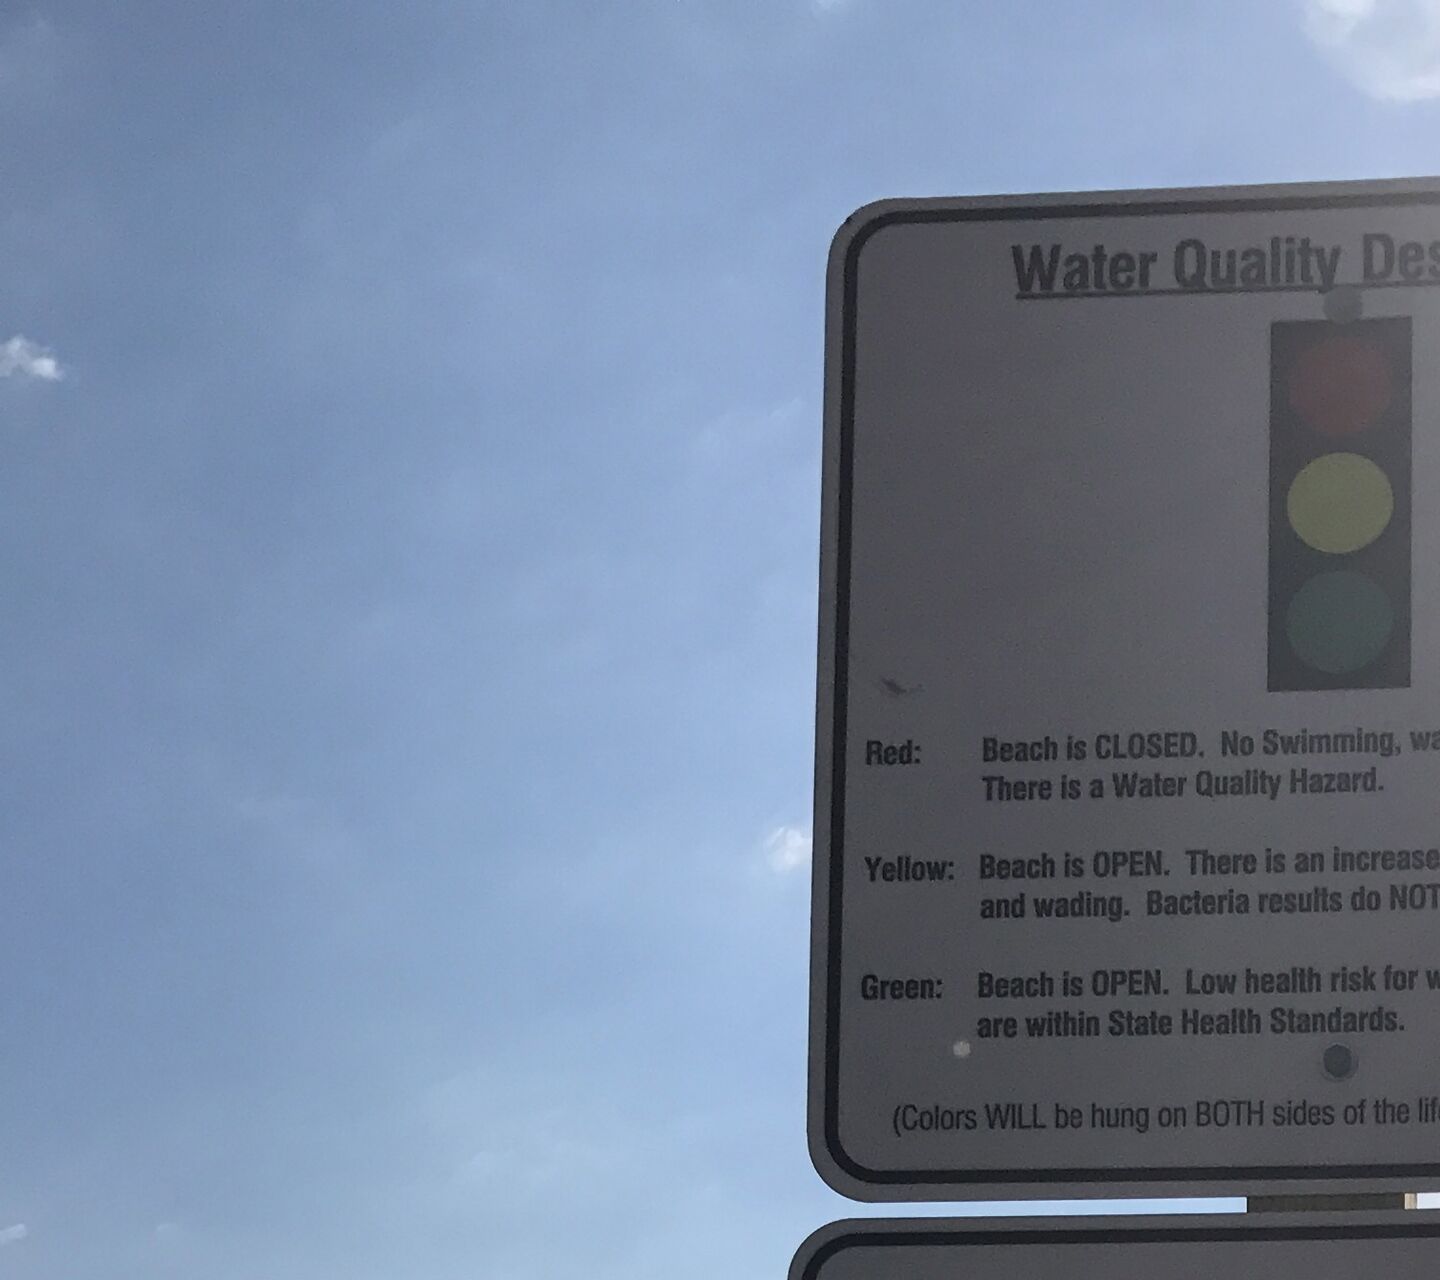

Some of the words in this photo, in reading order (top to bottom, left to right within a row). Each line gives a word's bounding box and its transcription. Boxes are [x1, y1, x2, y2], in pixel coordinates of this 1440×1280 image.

[1011, 244, 1158, 293] Water
[1174, 236, 1341, 291] Quality
[865, 739, 921, 766] Red:
[982, 737, 1058, 762] Beach
[1066, 735, 1087, 761] is
[1094, 732, 1205, 759] CLOSED.
[1221, 730, 1255, 757] No
[1262, 728, 1402, 757] Swimming,
[981, 775, 1053, 801] There
[1060, 774, 1082, 800] is
[1089, 779, 1104, 799] a
[1111, 772, 1188, 798] Water
[1195, 769, 1282, 800] Quality
[1289, 767, 1385, 794] Hazard.
[892, 1104, 978, 1136] (Colors
[984, 1103, 1047, 1130] WILL
[1054, 1103, 1083, 1129] be
[1091, 1103, 1150, 1134] hung
[1157, 1106, 1187, 1127] on
[1195, 1099, 1265, 1127] BOTH
[1272, 1100, 1335, 1126] sides
[1343, 1098, 1367, 1125] of
[1372, 1098, 1410, 1125] the
